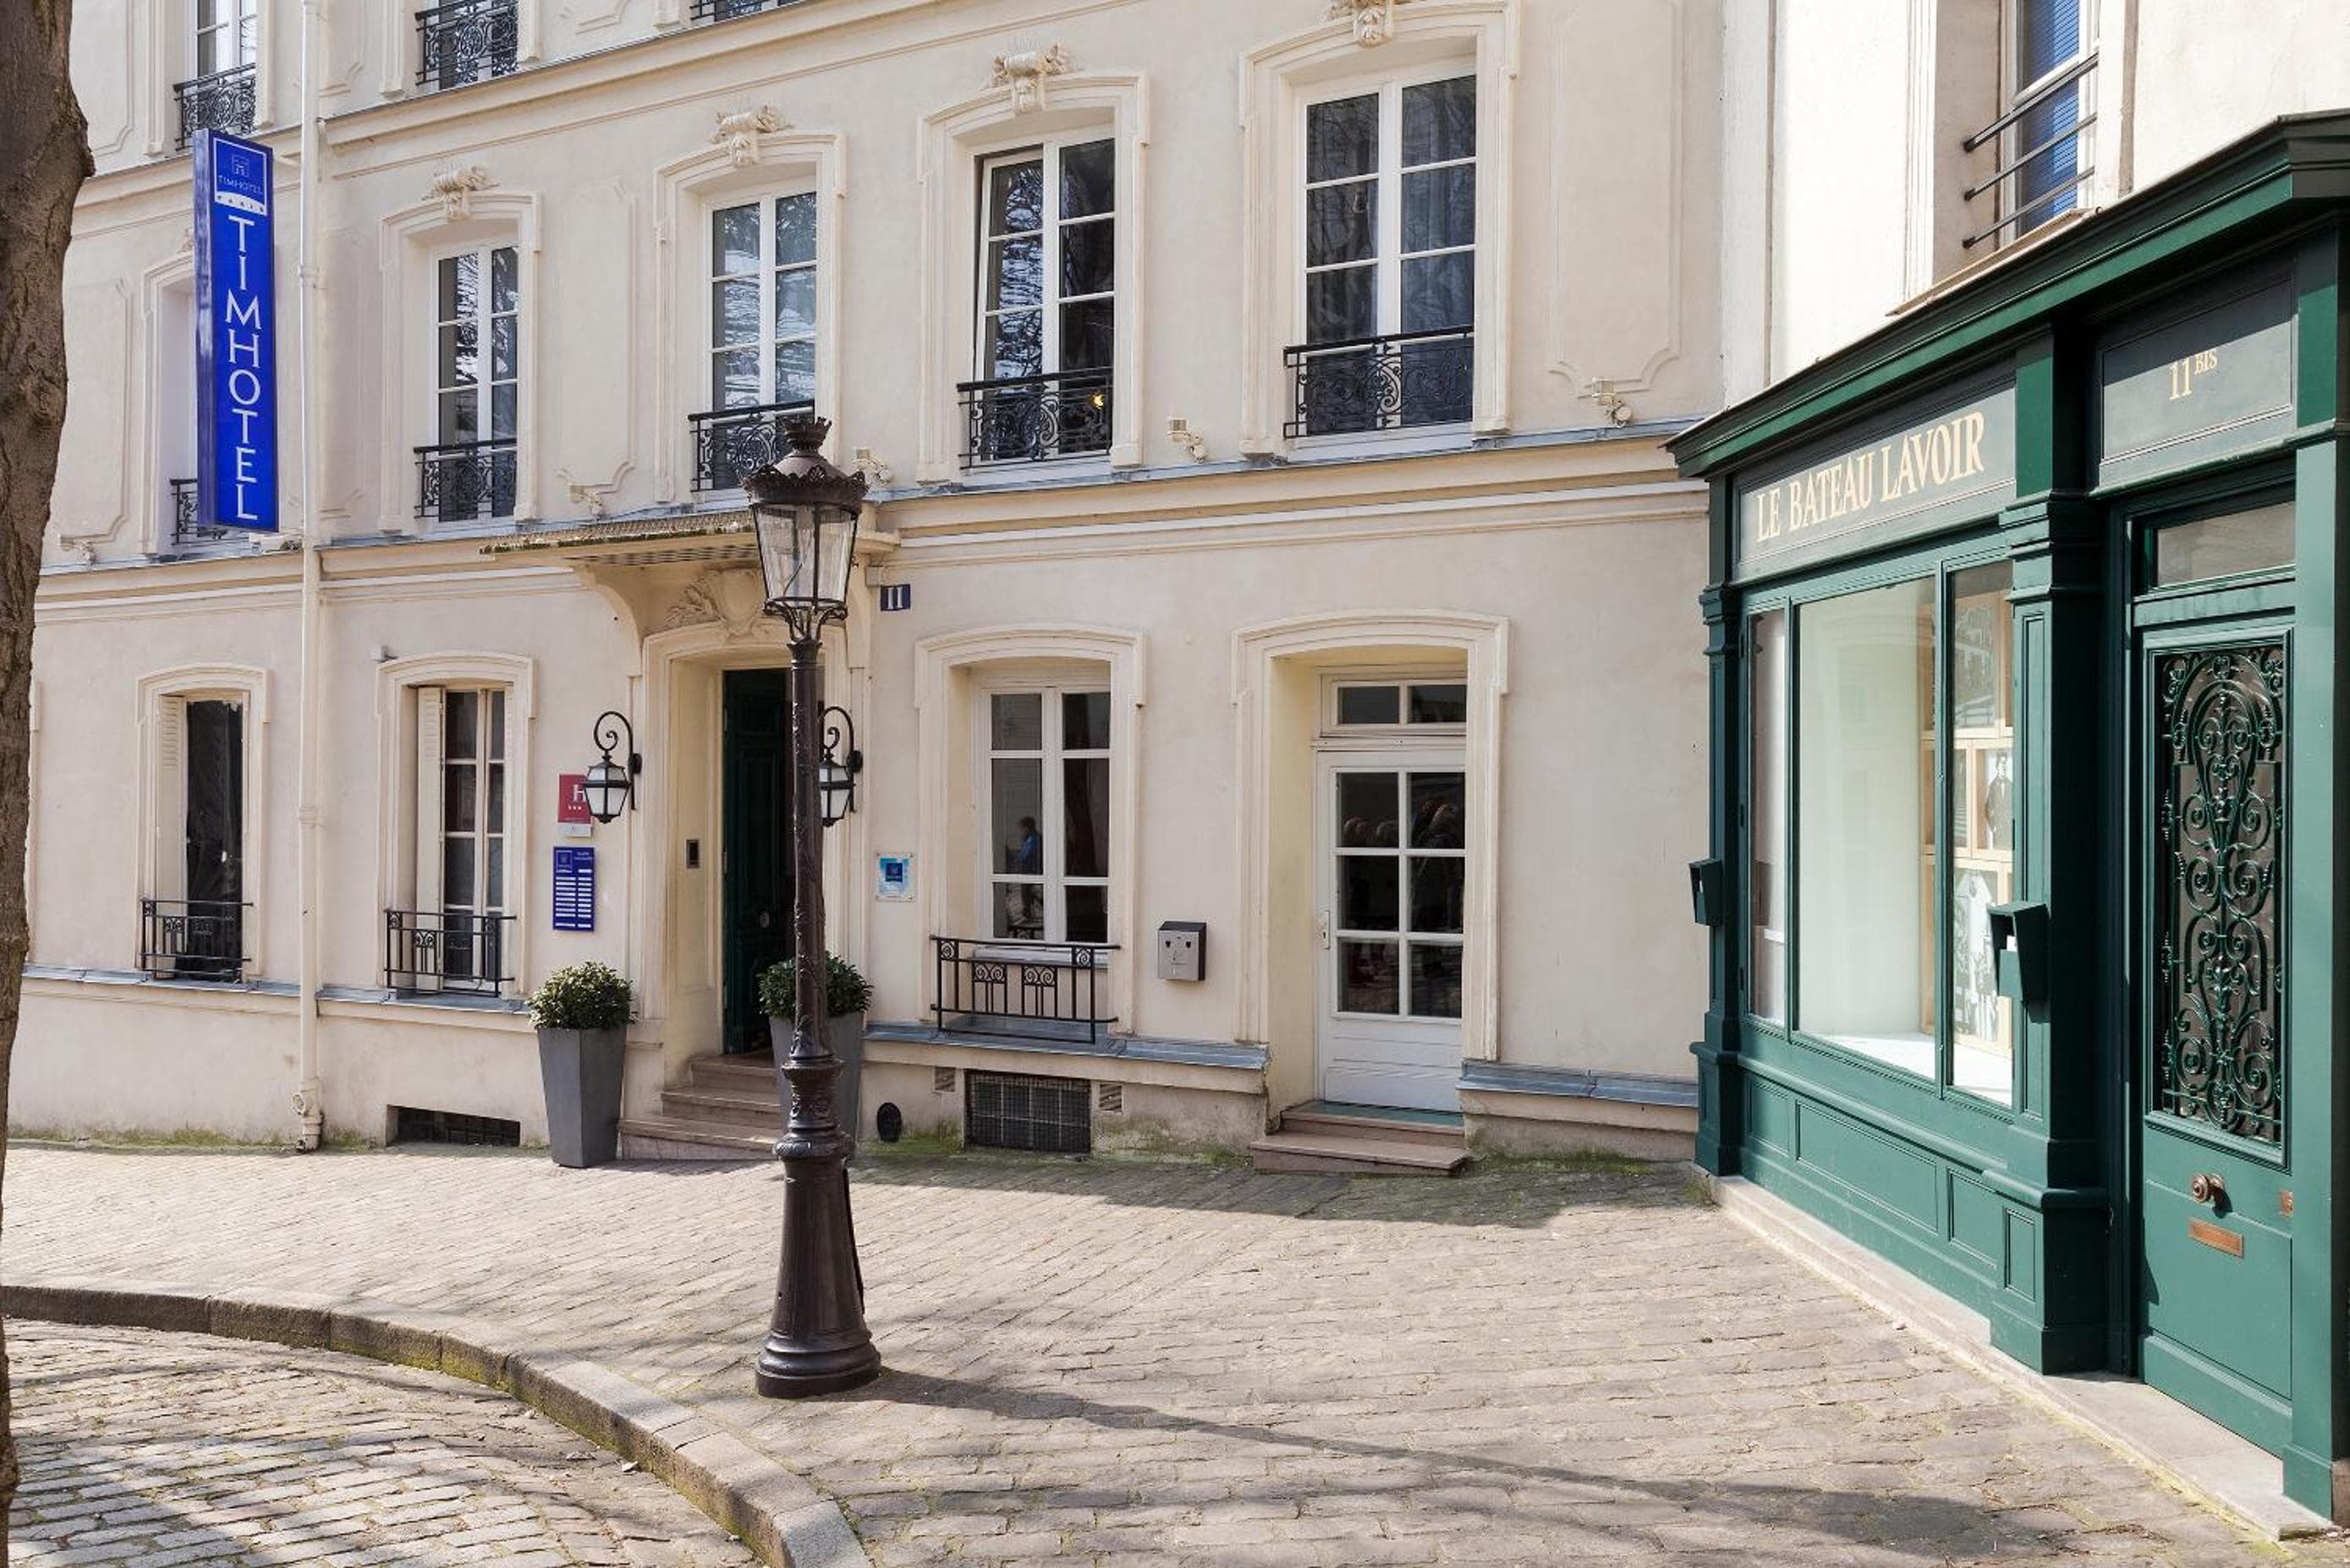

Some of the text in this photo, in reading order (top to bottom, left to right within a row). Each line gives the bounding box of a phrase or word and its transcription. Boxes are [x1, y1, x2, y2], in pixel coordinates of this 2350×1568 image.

[224, 215, 262, 522] TIMHOTEL
[2168, 348, 2219, 401] 11 BIS
[1756, 411, 1985, 543] LE BATEAU LAVOIR
[888, 587, 903, 609] 11
[573, 784, 586, 803] H
